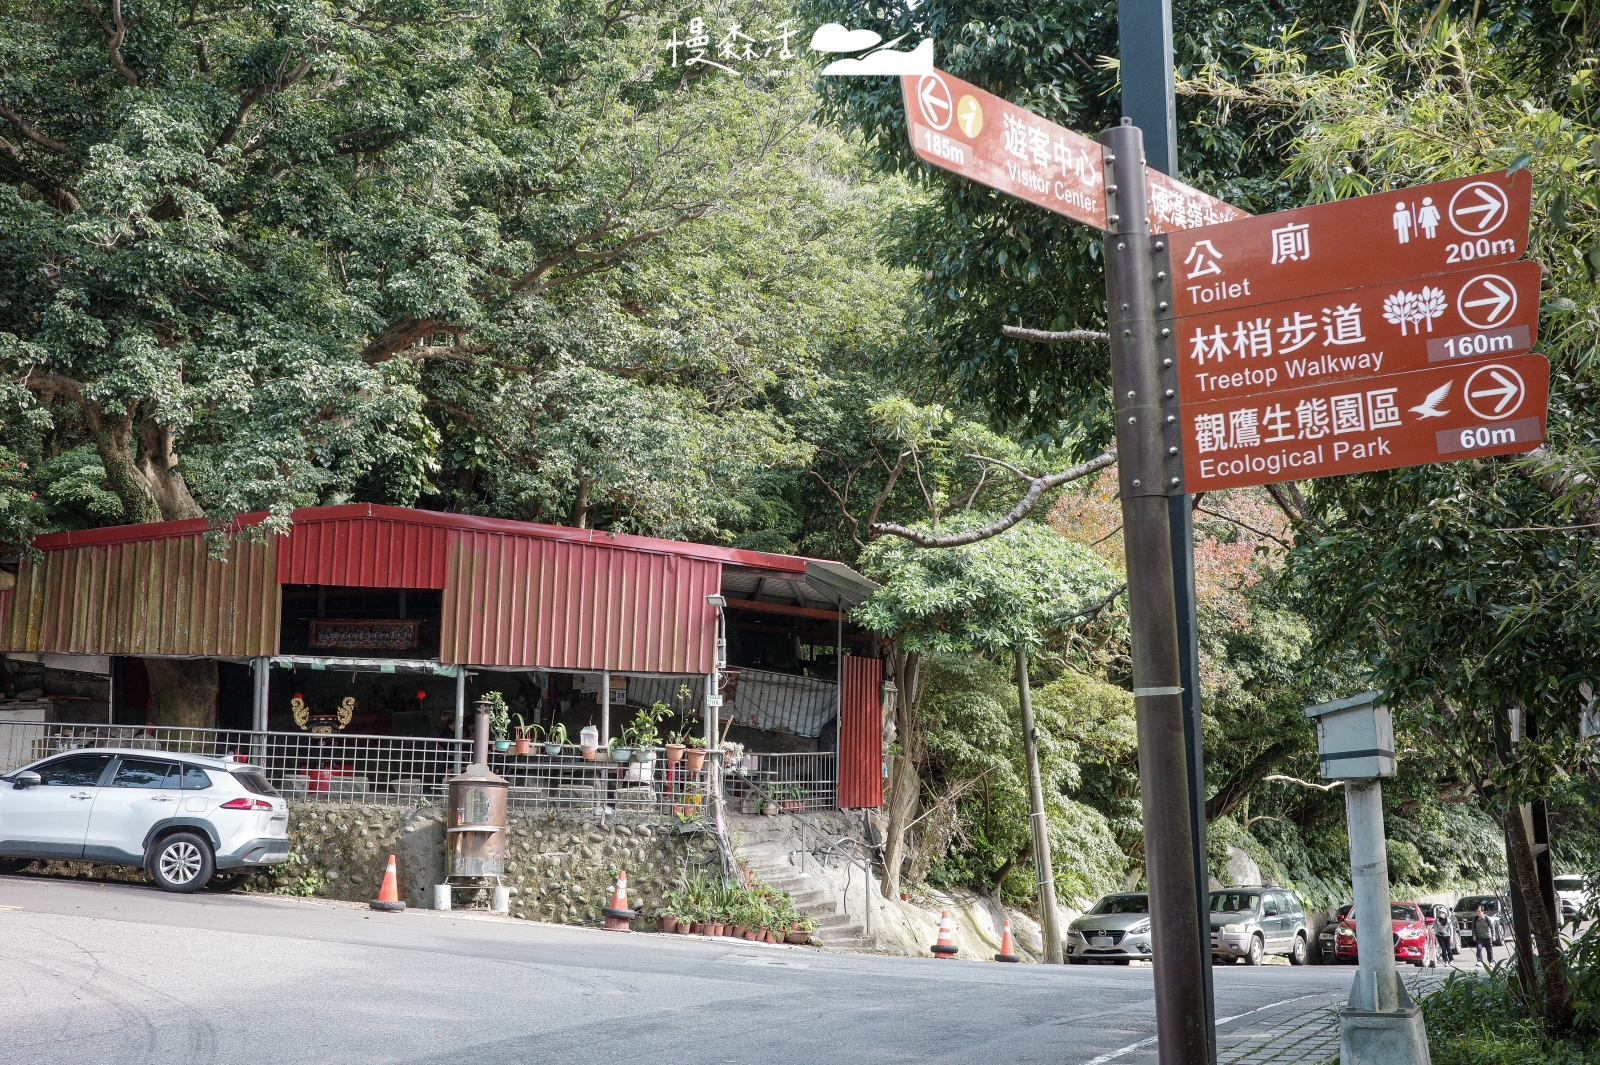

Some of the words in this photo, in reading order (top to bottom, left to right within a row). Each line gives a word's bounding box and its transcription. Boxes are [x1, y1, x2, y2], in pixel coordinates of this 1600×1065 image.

[924, 130, 964, 165] 185m
[1003, 112, 1097, 187] 遊客中心
[1007, 160, 1050, 194] Visitor
[1054, 181, 1096, 213] Center
[1445, 238, 1515, 264] 200m
[1187, 278, 1251, 305] Toilet
[1190, 303, 1366, 365] 林梢步道
[1444, 334, 1513, 357] 160m
[1195, 367, 1278, 392] Treetop
[1285, 351, 1384, 379] Walkway
[1194, 387, 1402, 454] 觀鷹生態園區
[1460, 427, 1516, 448] 60m
[1200, 445, 1323, 478] Ecological
[1334, 437, 1391, 461] Park
